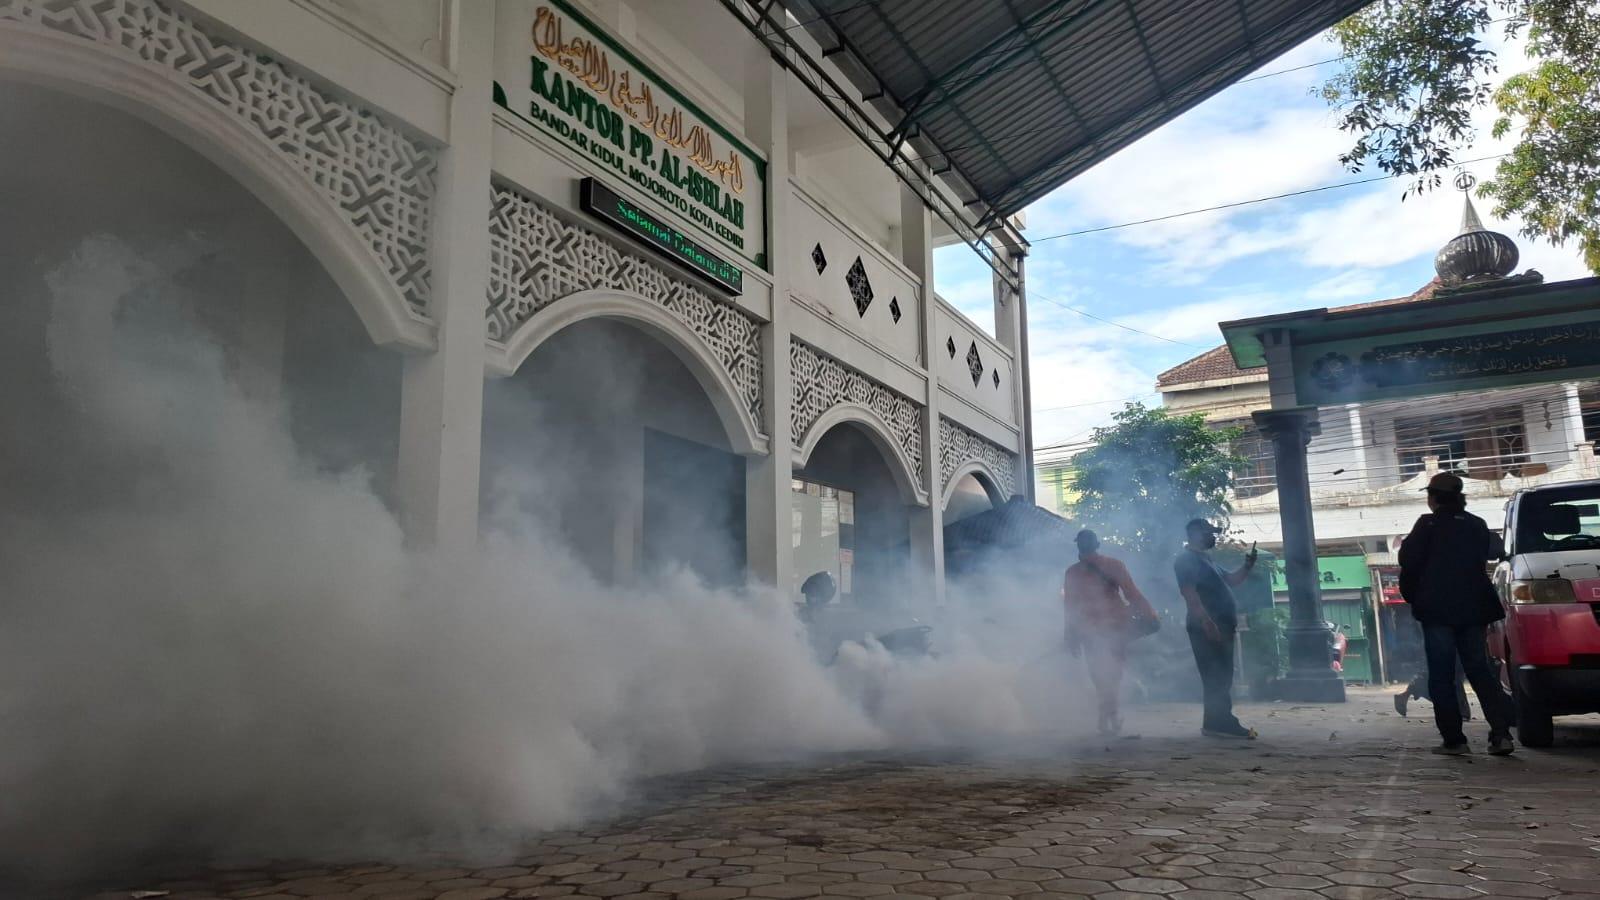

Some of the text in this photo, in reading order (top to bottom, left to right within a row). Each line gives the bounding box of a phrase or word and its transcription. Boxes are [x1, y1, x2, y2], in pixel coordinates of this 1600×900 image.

[531, 55, 745, 230] KANTOR PP. AL-ISHLAH
[531, 101, 588, 151] BANDAR
[590, 140, 628, 176] KIDUL
[629, 164, 689, 213] MOJOROTO
[689, 204, 715, 232] KOTA
[715, 221, 744, 250] KEDIRI
